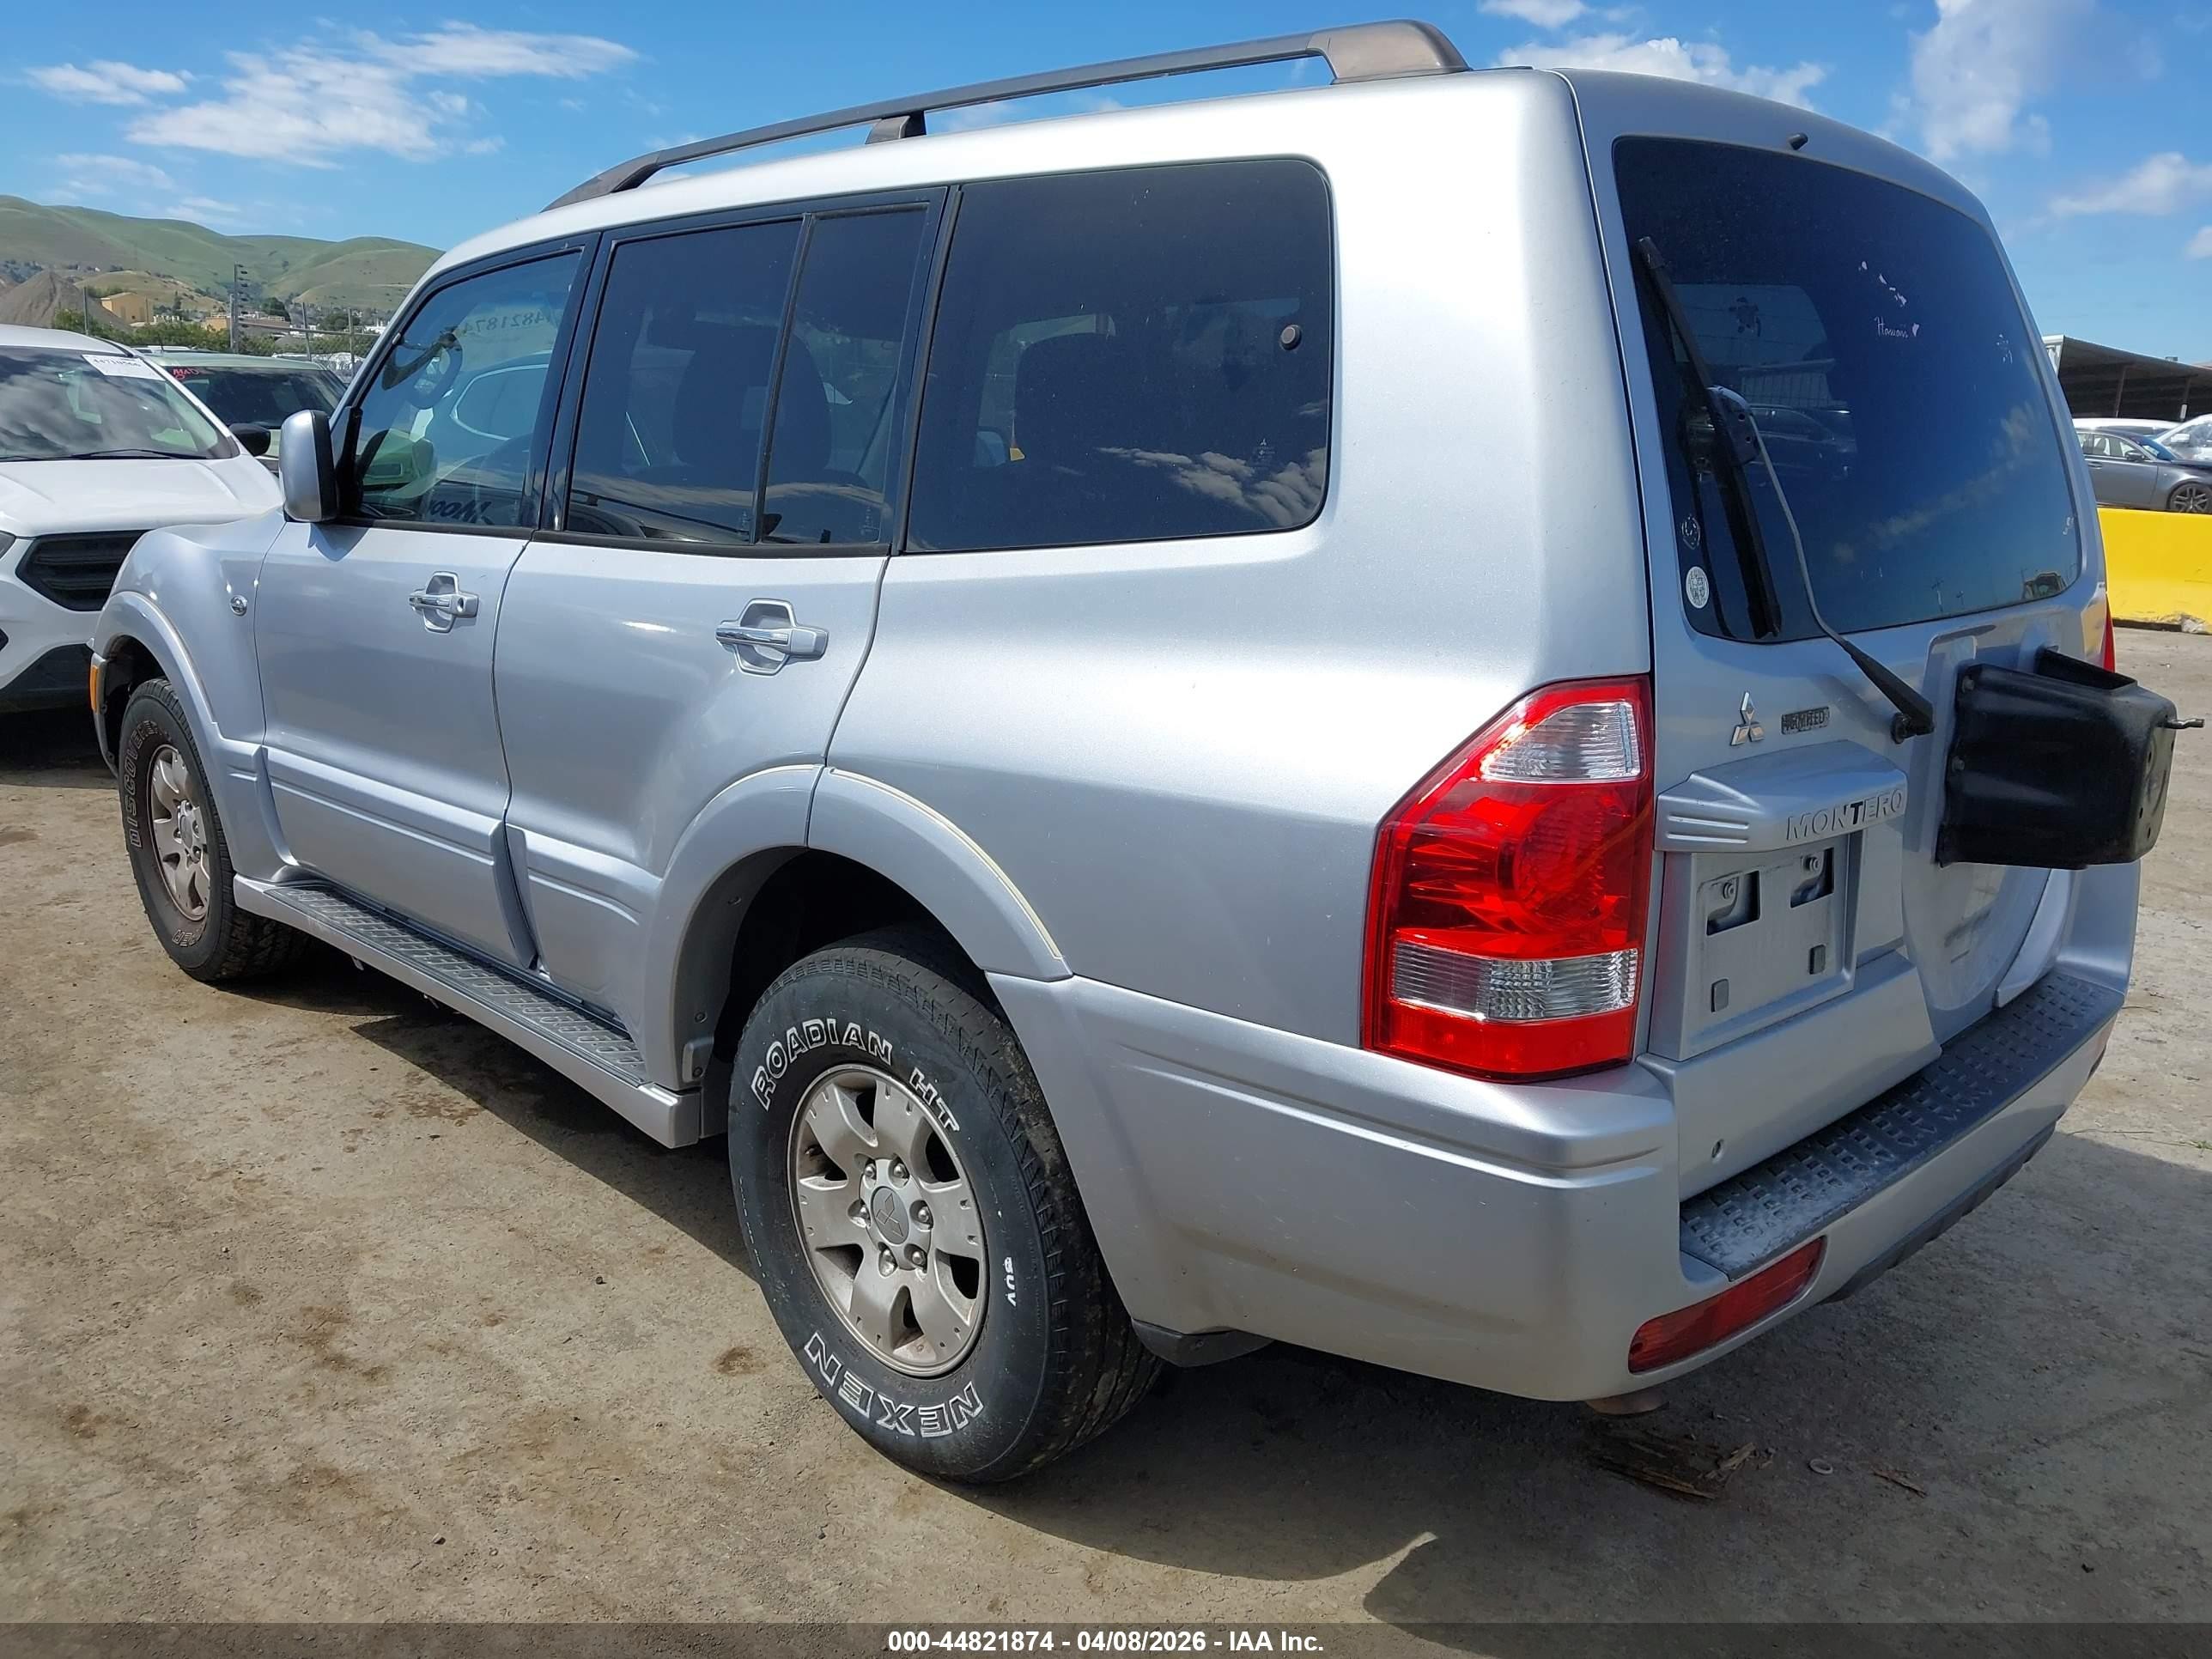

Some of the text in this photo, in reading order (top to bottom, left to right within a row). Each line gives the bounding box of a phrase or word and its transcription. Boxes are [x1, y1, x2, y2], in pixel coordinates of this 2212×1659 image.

[1786, 788, 1903, 841] MONTERO
[750, 1018, 960, 1133] ROADIAN HT
[1002, 1256, 1017, 1307] SUV
[804, 1330, 985, 1437] NEXEN
